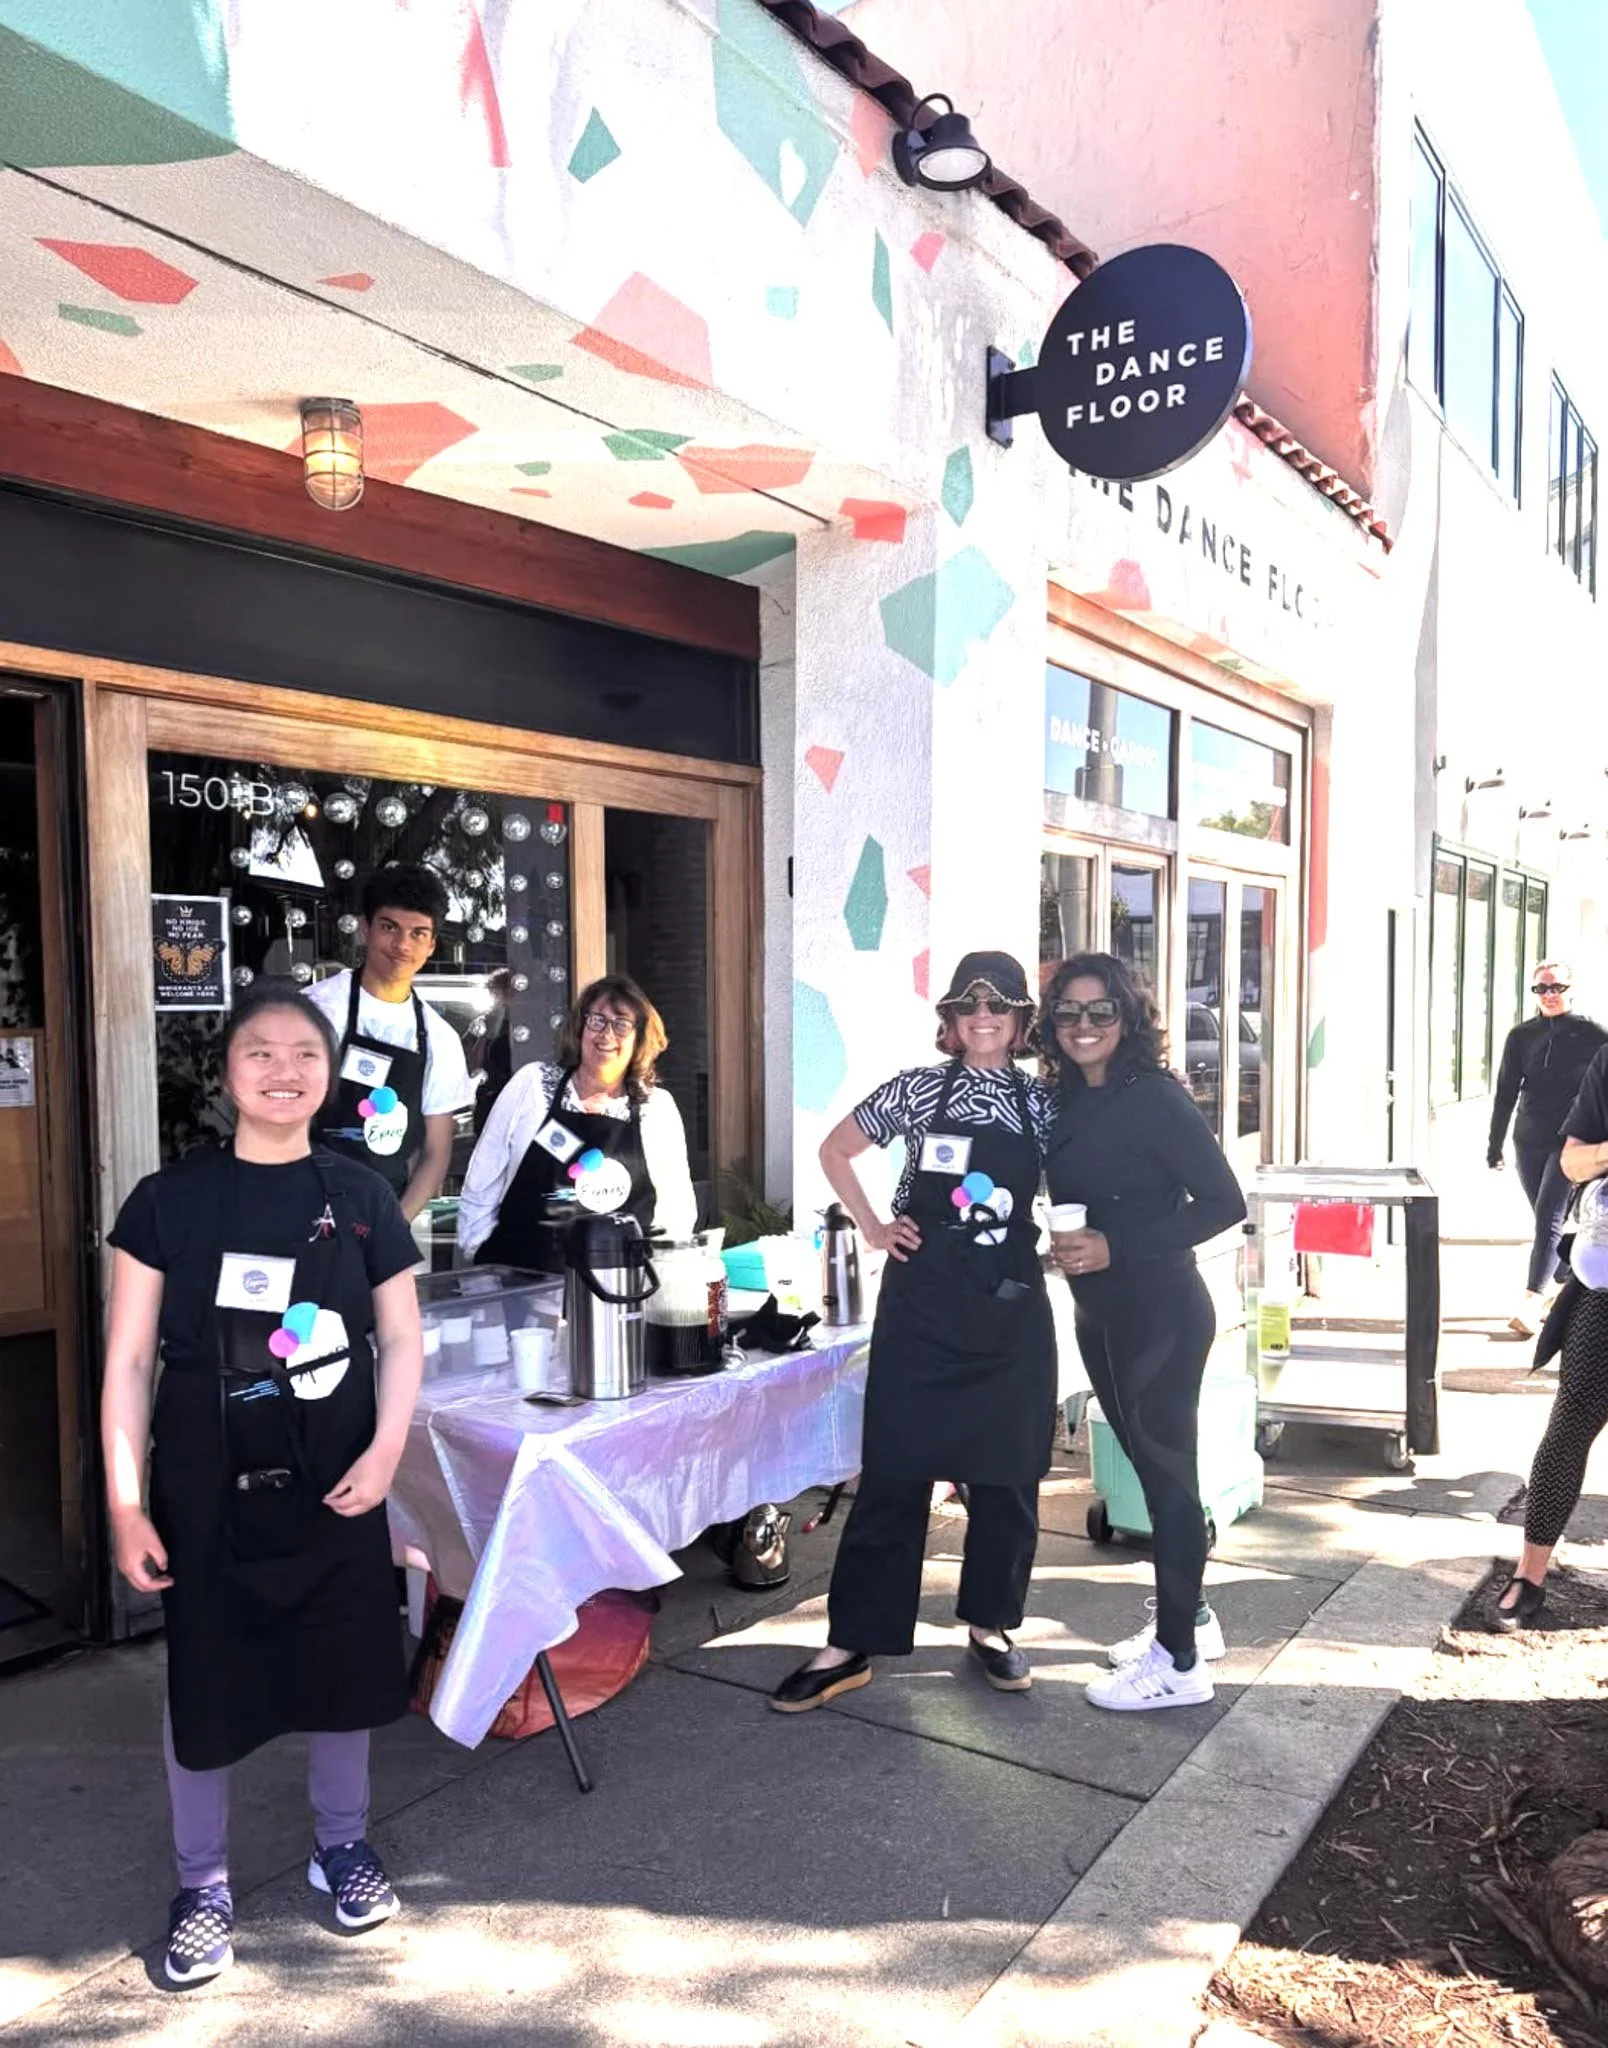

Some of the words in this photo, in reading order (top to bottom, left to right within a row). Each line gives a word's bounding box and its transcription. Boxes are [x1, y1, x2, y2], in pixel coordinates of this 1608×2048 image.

[1066, 319, 1135, 356] THE
[1096, 336, 1224, 386] DANCE
[1066, 384, 1187, 429] FLOOR
[1156, 484, 1252, 587] DANCE
[1050, 715, 1101, 753] DANCE
[165, 918, 177, 926] NO
[167, 931, 180, 939] NO
